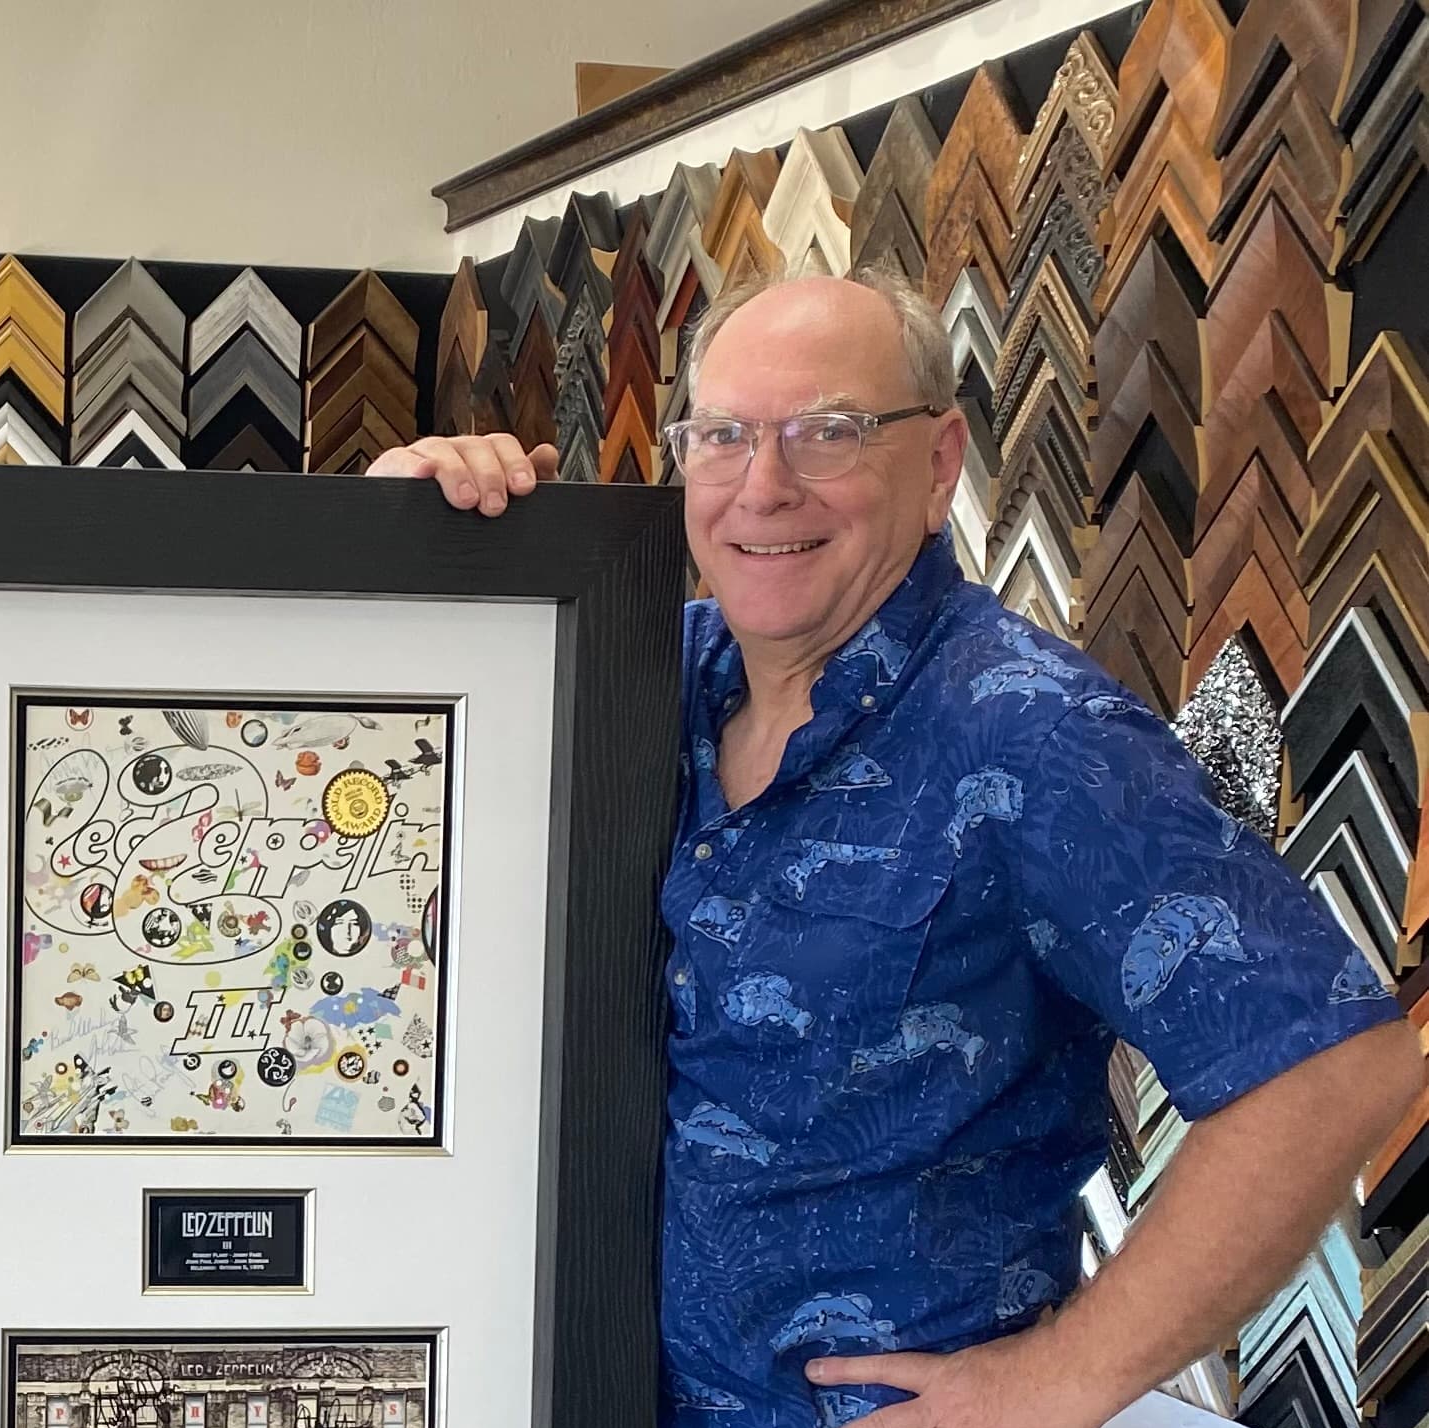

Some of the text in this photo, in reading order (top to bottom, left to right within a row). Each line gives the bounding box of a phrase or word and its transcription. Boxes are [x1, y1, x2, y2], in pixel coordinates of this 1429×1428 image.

[331, 777, 383, 821] GOLD RECORD
[341, 807, 381, 830] AWARD
[182, 1211, 273, 1238] LED ZEPPELIN
[180, 1363, 274, 1376] LED ZEPPELIN
[389, 1404, 398, 1416] S
